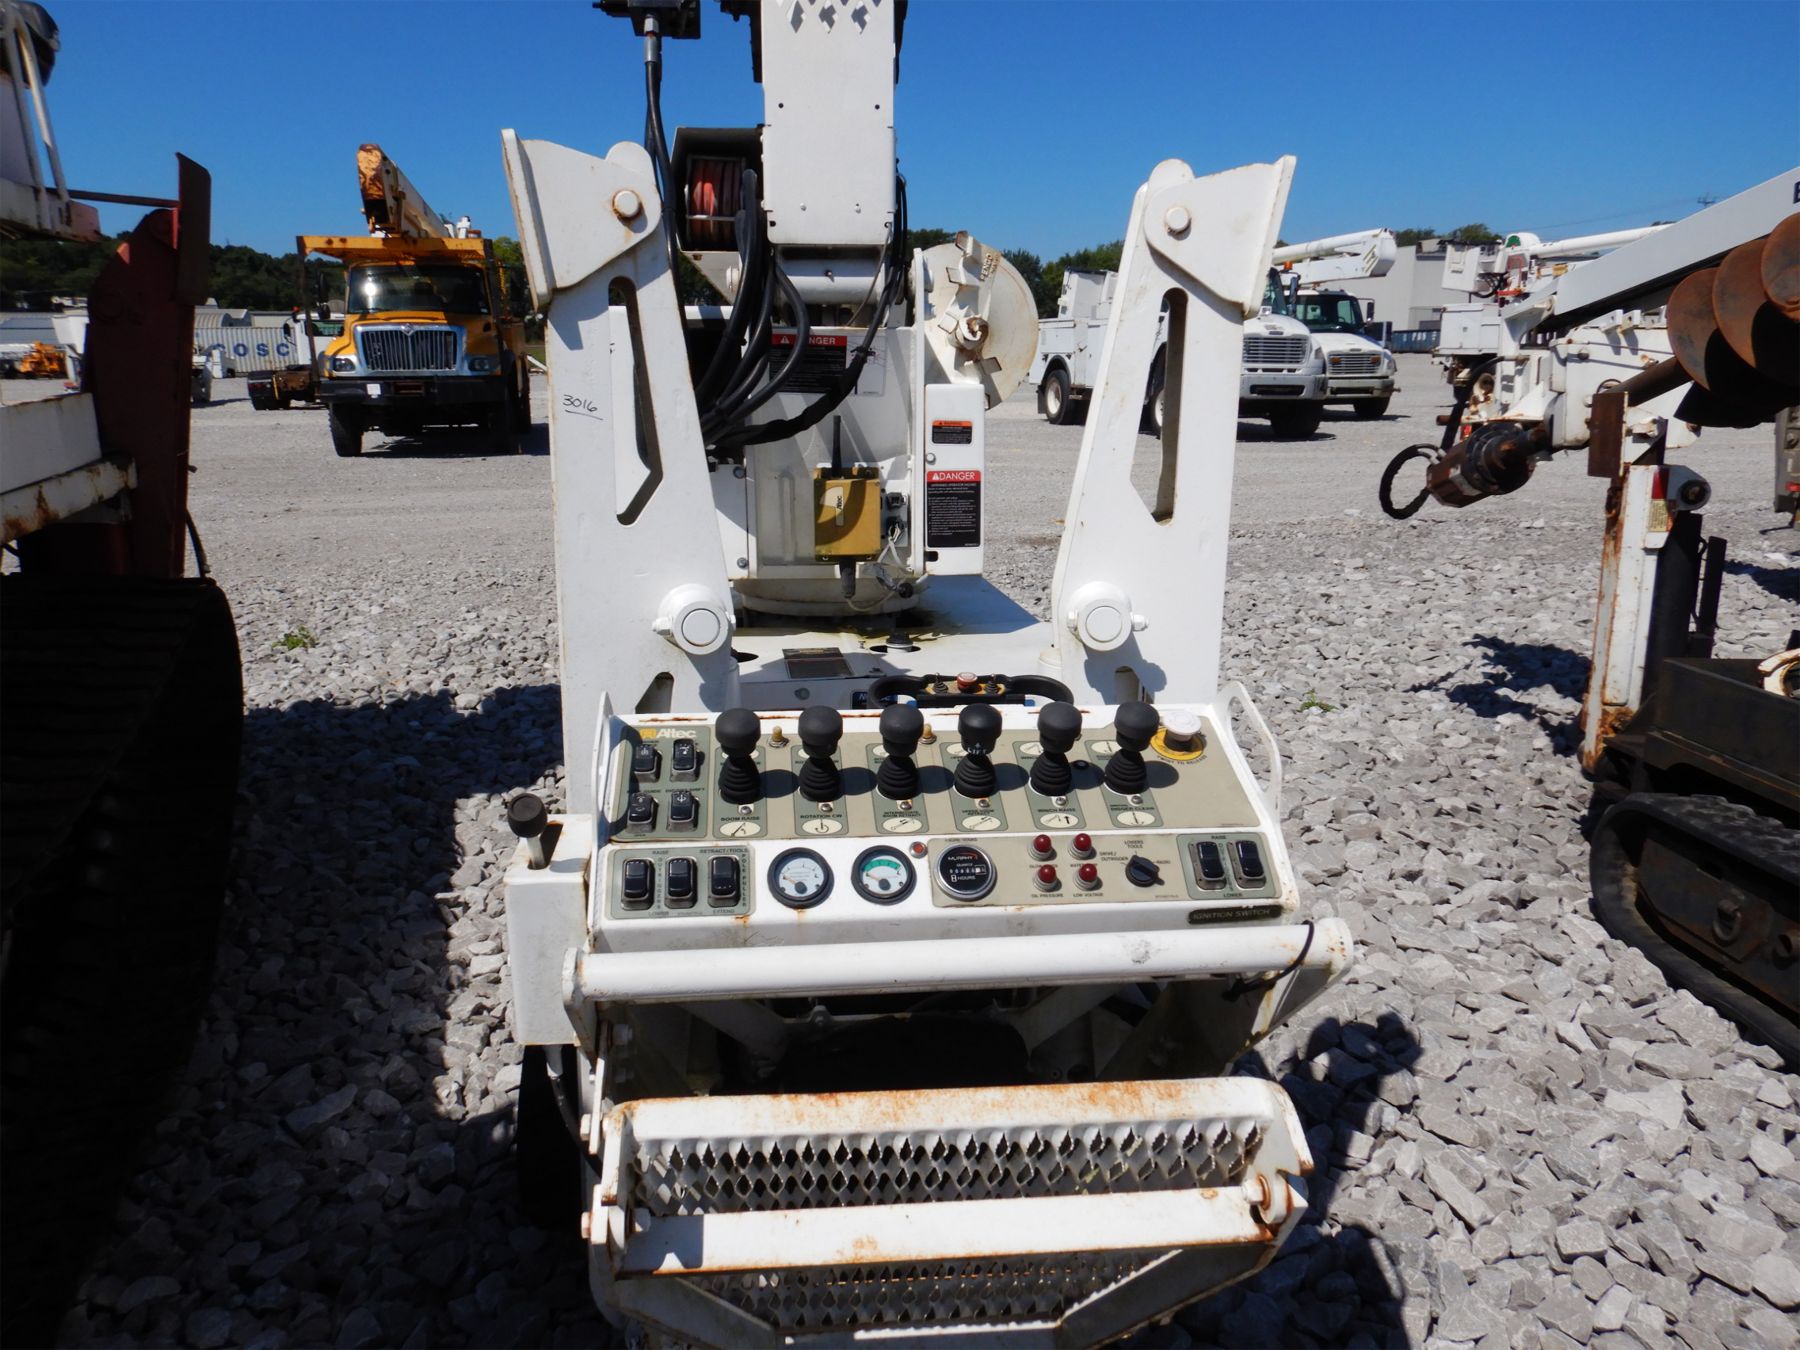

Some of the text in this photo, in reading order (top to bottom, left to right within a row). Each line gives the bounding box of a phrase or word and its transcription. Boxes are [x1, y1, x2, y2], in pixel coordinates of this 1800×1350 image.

[808, 336, 836, 345] NGER
[562, 394, 598, 413] 3016
[939, 471, 976, 481] DANGER
[656, 728, 697, 738] Altec
[1193, 908, 1271, 920] IGNITION SWITCH
